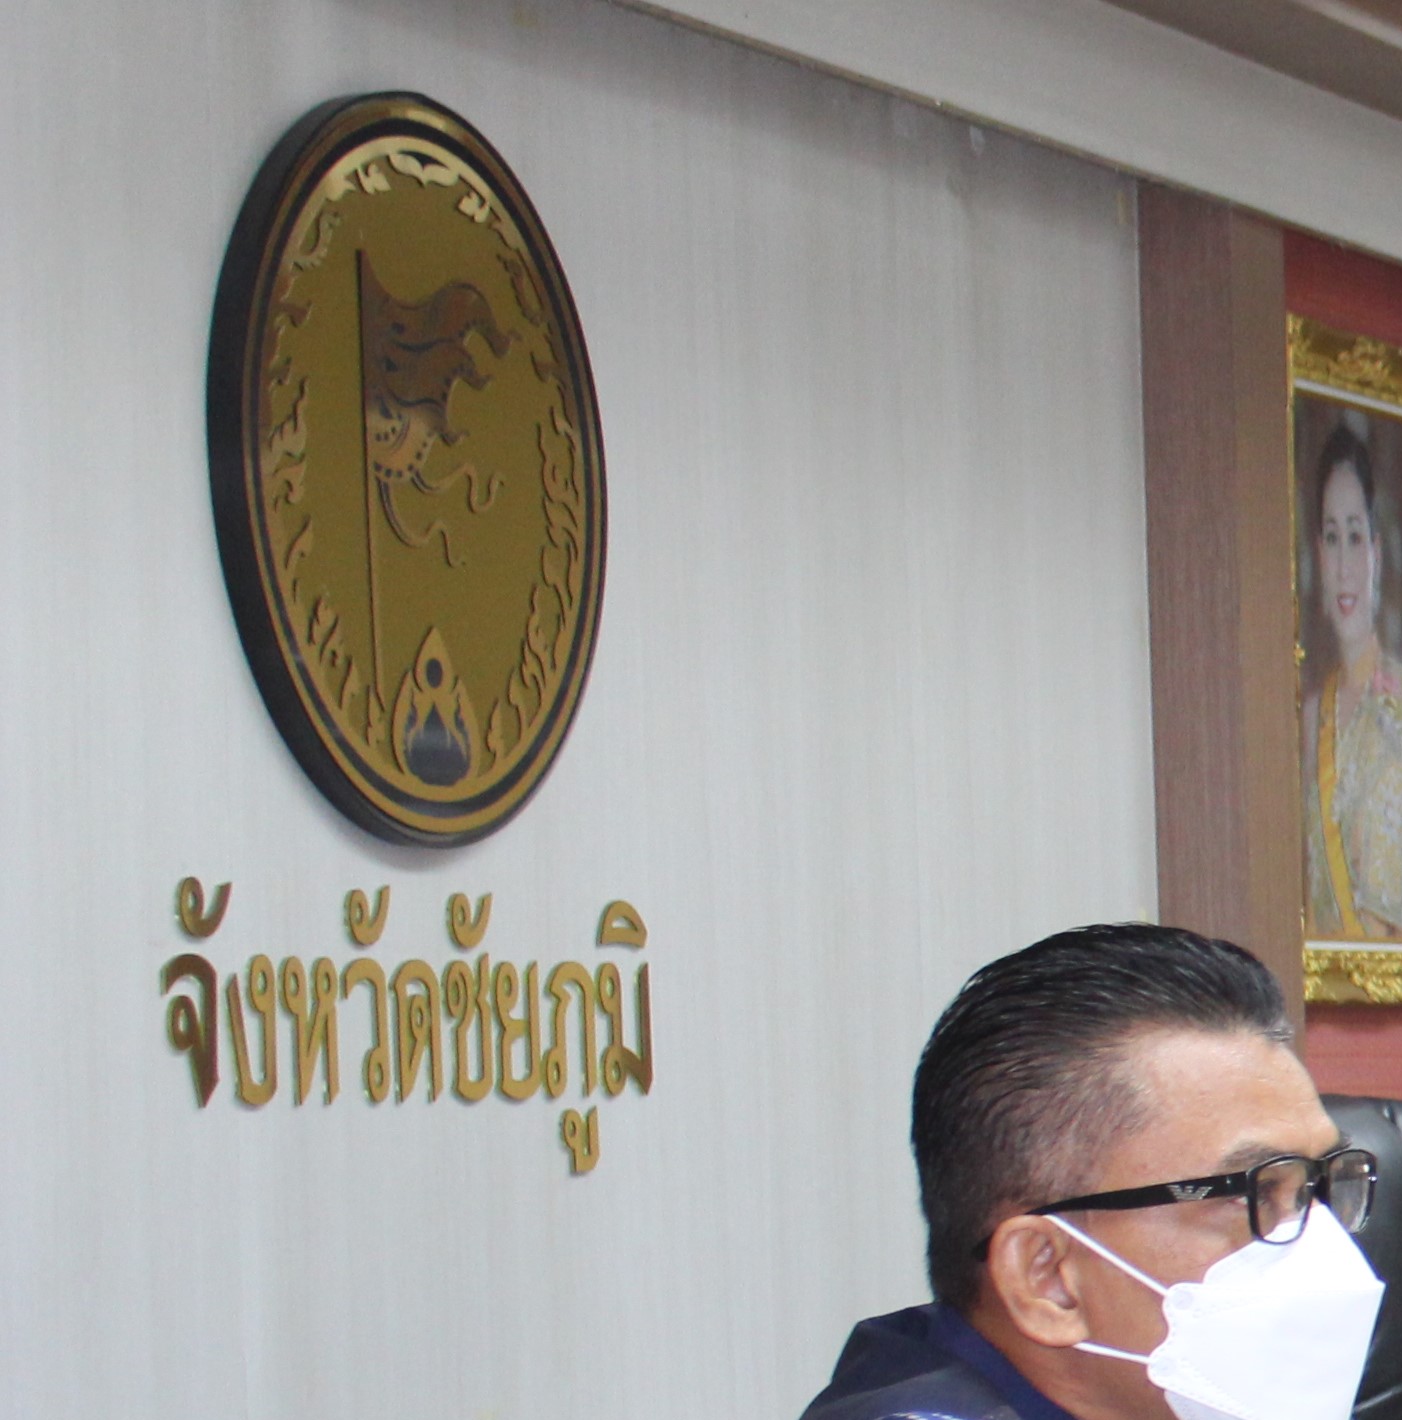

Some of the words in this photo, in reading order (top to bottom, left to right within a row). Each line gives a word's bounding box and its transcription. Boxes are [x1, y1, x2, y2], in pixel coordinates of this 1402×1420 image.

[159, 876, 653, 1173] จังหวัดชัยภูมิ
